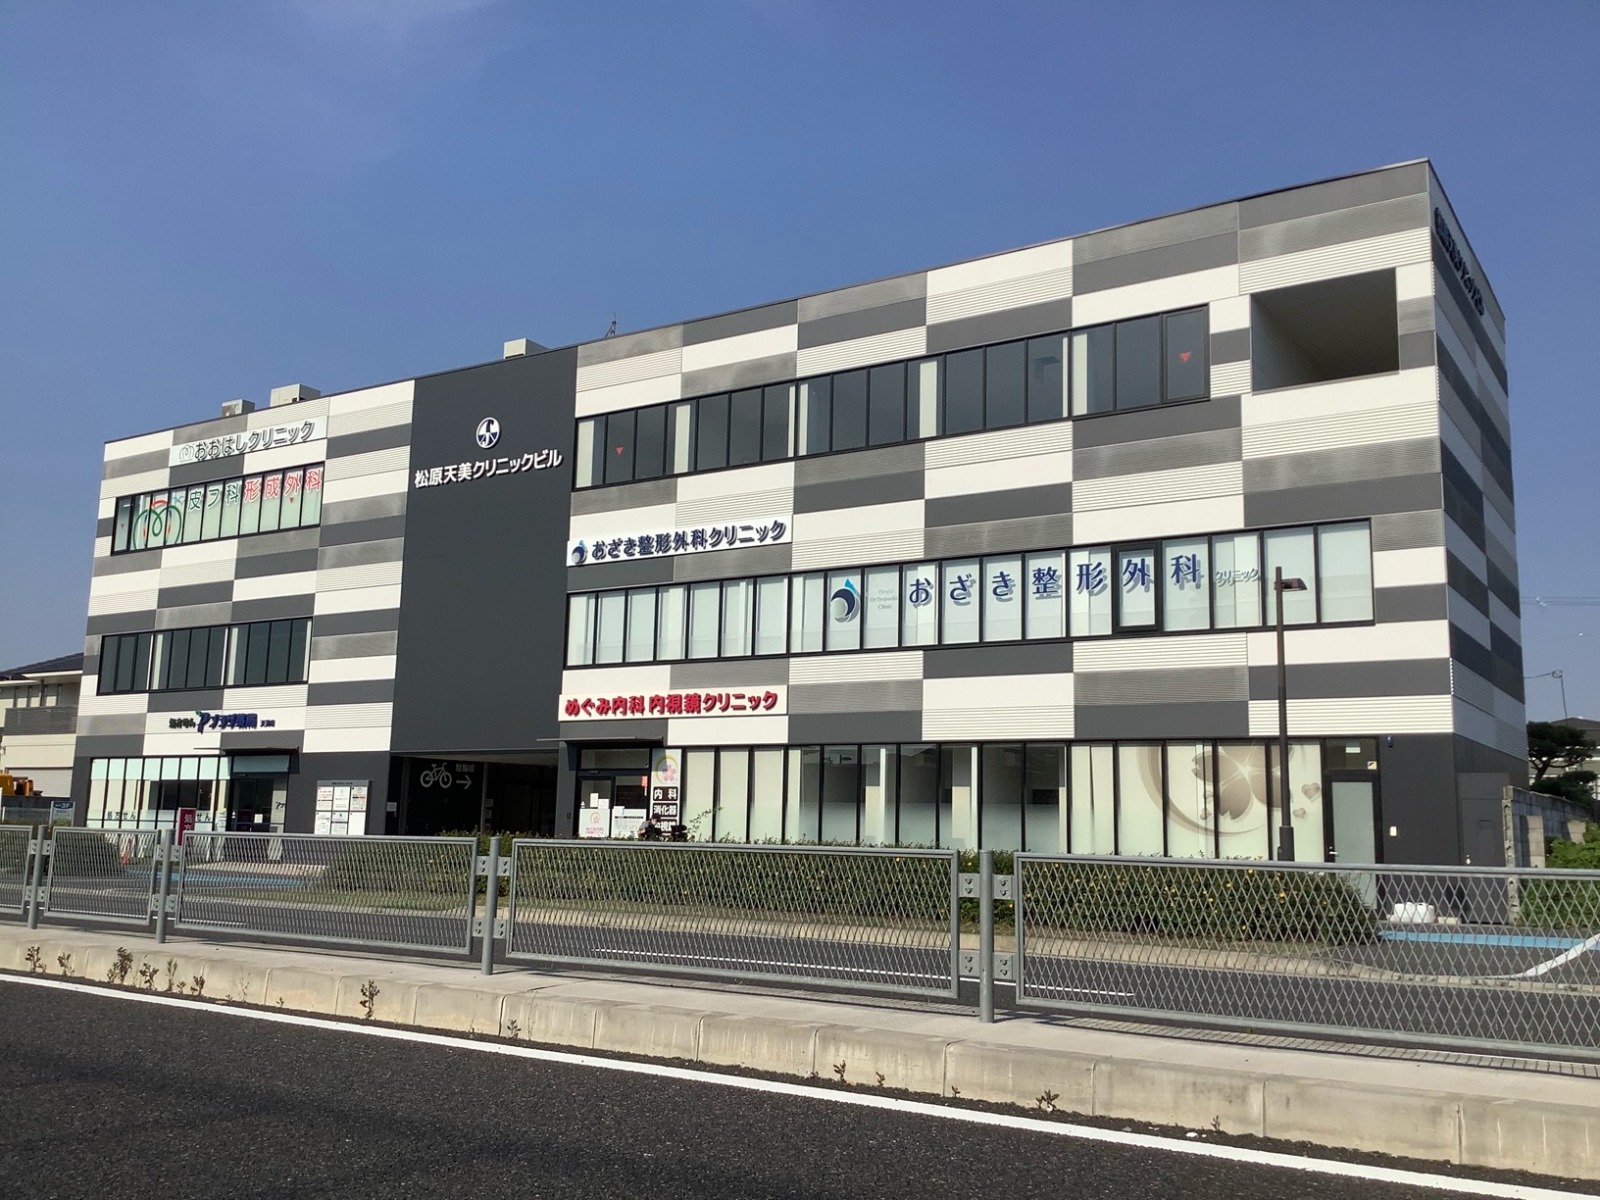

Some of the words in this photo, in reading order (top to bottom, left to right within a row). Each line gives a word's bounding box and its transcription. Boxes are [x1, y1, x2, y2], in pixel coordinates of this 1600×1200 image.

[194, 420, 315, 461] おおはしクリニック
[414, 448, 562, 487] 松原天美クリニックビル
[188, 482, 240, 510] 皮フ科
[244, 469, 322, 502] 形成外科
[591, 520, 787, 560] おざき整形外科クリニック
[565, 695, 645, 717] めぐみ内科
[648, 690, 778, 715] 内視鏡クリニック
[653, 788, 677, 800] 内科
